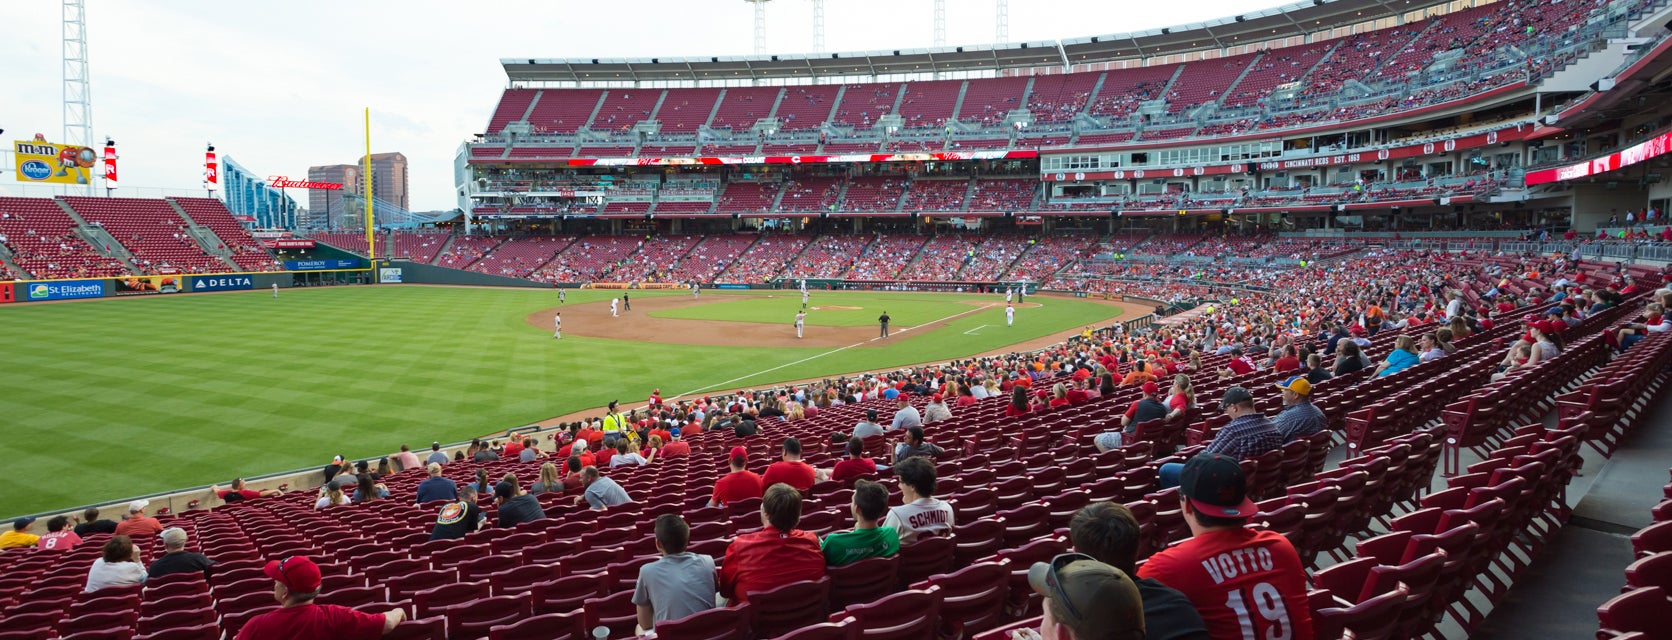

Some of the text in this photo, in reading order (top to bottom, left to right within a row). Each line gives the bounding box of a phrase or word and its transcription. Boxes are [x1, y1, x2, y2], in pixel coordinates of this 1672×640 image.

[1284, 153, 1360, 168] CINCINNATI REDS EST. 1869
[25, 162, 50, 177] Kroger
[61, 284, 100, 293] Elizabeth
[209, 278, 251, 287] DELTA
[909, 510, 949, 529] SCHMIDT
[45, 537, 57, 549] 8
[1201, 547, 1274, 585] VOTTO
[1225, 582, 1292, 640] 19
